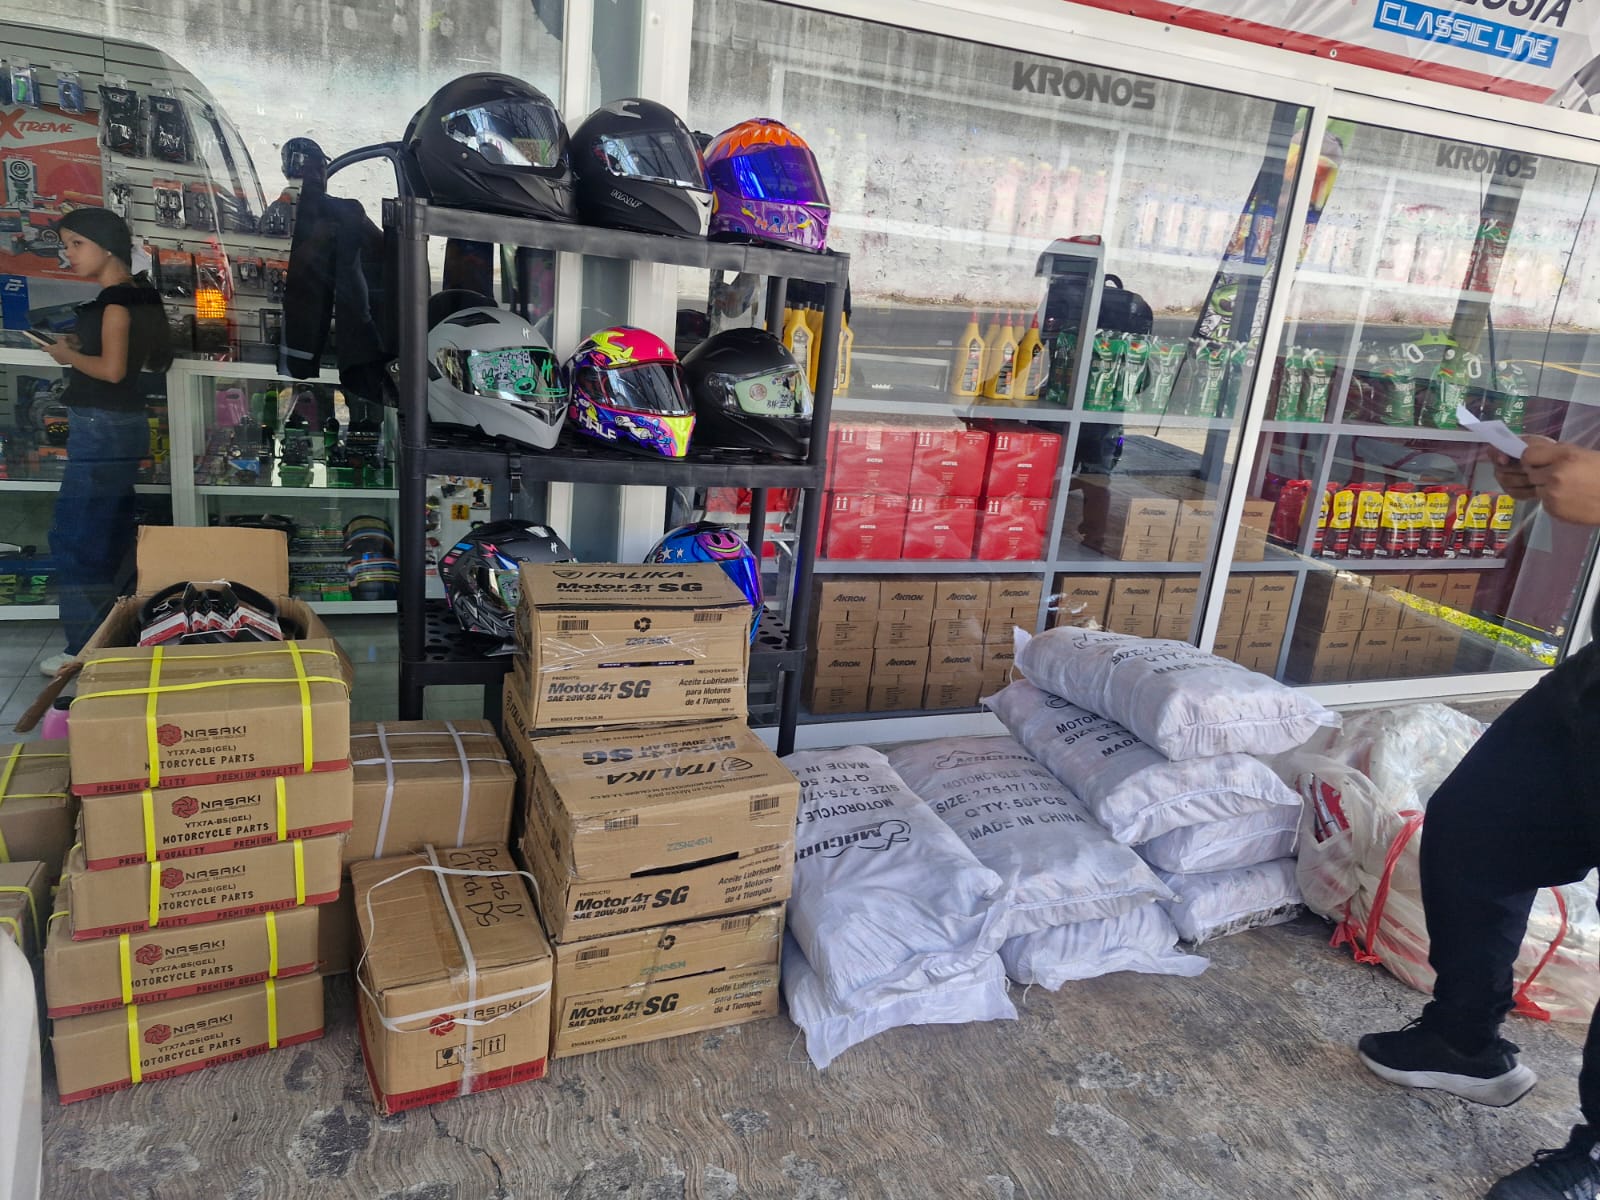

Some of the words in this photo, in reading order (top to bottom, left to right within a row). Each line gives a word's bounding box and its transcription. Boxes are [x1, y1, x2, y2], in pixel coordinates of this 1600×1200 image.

[1379, 2, 1494, 47] CLASSIC
[1494, 29, 1552, 61] LINE
[1012, 61, 1156, 110] KRONOS
[1436, 143, 1538, 179] KRONOS
[579, 413, 617, 440] HALF
[585, 571, 684, 579] ITALIKA
[556, 582, 625, 590] Motor
[658, 582, 703, 592] SG
[833, 593, 866, 602] AKRON
[891, 592, 924, 601] AKRON
[946, 592, 977, 601] AKRON
[828, 659, 861, 668] AKRON
[885, 658, 917, 666] AKRON
[679, 678, 701, 686] Aceite
[702, 676, 739, 685] Lubricante
[548, 682, 598, 694] Motor
[617, 680, 651, 699] SG
[685, 688, 702, 697] para
[704, 686, 731, 695] Motores
[702, 697, 731, 706] Tiempos
[183, 725, 247, 738] NASAKI
[145, 757, 216, 770] MTORCYCLE
[221, 753, 255, 765] PARTS
[583, 748, 633, 765] SG
[607, 761, 716, 785] ITALIKA
[805, 765, 821, 773] IN
[826, 762, 870, 770] MADE
[144, 777, 186, 789] QALITY
[216, 771, 257, 782] PREMIUM
[261, 766, 299, 777] QUALITY
[942, 771, 1021, 789] MOTORCYCLE
[863, 784, 900, 795] SIZE:
[201, 795, 261, 809] NASAKI
[936, 793, 970, 814] SIZE:
[964, 801, 1010, 818] Q'TY:
[805, 798, 894, 822] MOTORCYCLE
[163, 828, 231, 844] MOTORCYCLE
[236, 822, 269, 834] PARTS
[967, 821, 1014, 840] MADE
[1017, 815, 1034, 826] IN
[1039, 813, 1086, 824] CHINA
[164, 847, 205, 860] QUALITY
[234, 836, 272, 848] PREMIUM
[185, 865, 246, 880] NASAKI
[718, 874, 742, 886] Aceite
[743, 864, 781, 880] Lubricante
[725, 884, 743, 895] para
[744, 878, 773, 889] Motores
[742, 887, 773, 901] Tiempos
[221, 891, 254, 902] PARTS
[574, 896, 631, 911] Motor
[652, 885, 690, 908] SG
[102, 925, 145, 936] PREMIUM
[216, 908, 256, 919] PREMIUM
[259, 901, 297, 912] QUALITY
[573, 912, 593, 920] SAE
[594, 907, 630, 918] 20W-50
[630, 904, 646, 913] API
[165, 940, 225, 955] NASAKI
[201, 965, 233, 977] PARTS
[196, 982, 236, 992] PREMIUM
[708, 986, 732, 995] Aceite
[569, 1004, 623, 1020] Motor
[642, 993, 679, 1016] SG
[732, 1000, 762, 1012] Tiempos
[173, 1014, 233, 1033] NASAKI
[568, 1020, 585, 1028] SAE
[587, 1015, 621, 1026] 20W-50
[209, 1037, 241, 1050] PARTS
